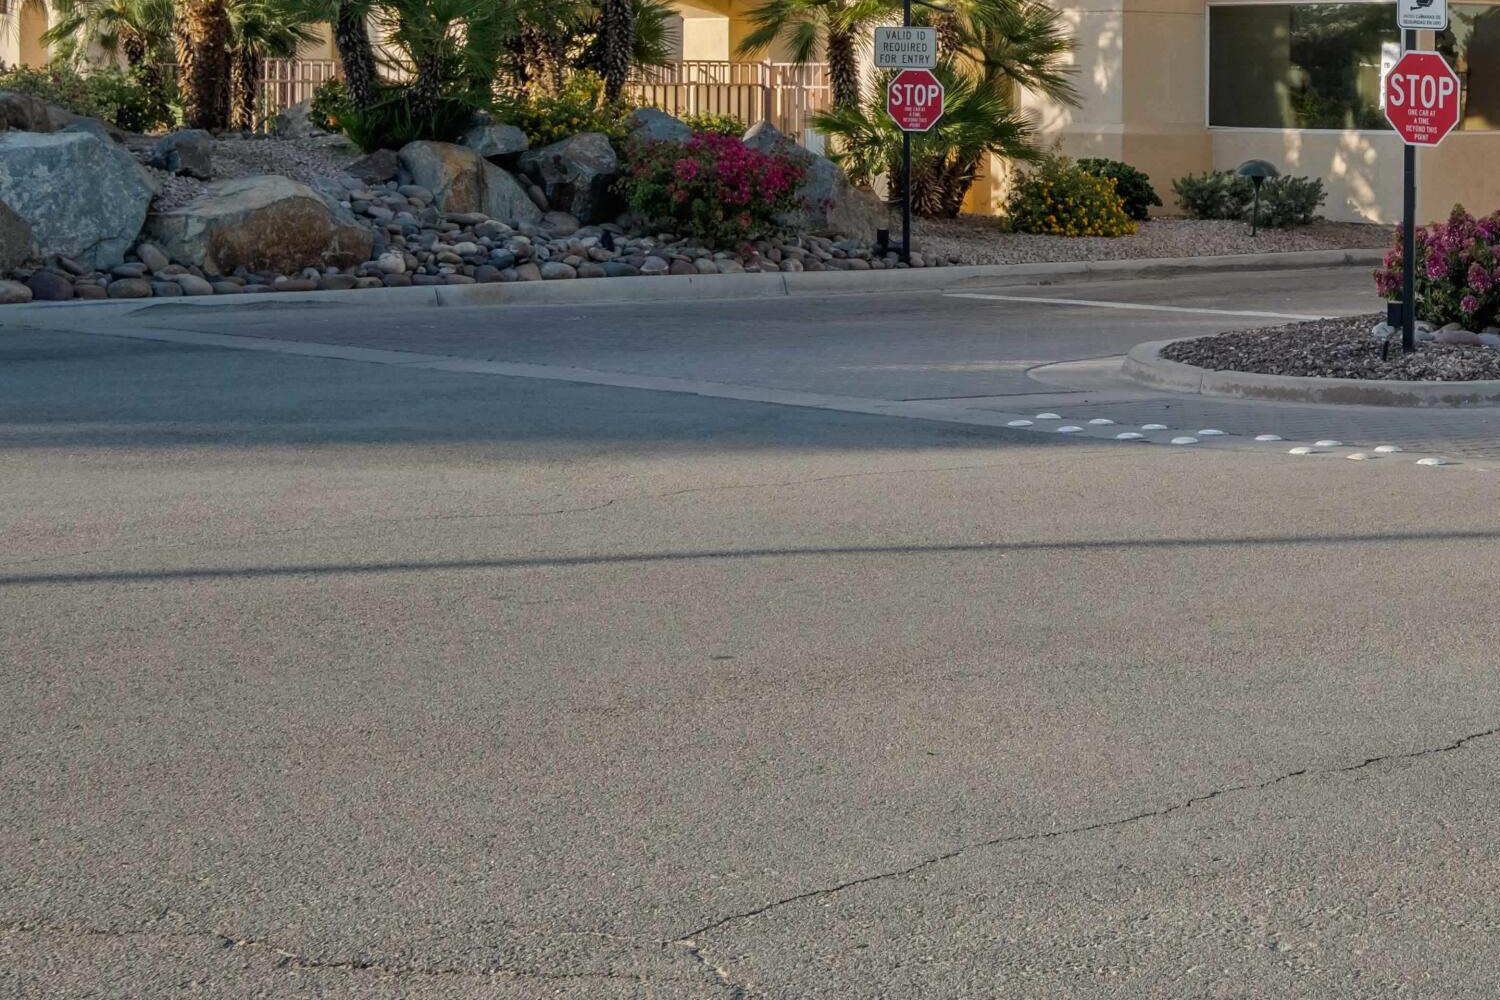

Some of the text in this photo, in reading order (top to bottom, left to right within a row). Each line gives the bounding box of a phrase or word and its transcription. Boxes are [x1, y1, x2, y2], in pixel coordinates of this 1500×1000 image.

[886, 31, 926, 41] VALID ID
[883, 42, 928, 52] REQUIRED
[880, 54, 930, 64] FOR ENTRY
[891, 84, 939, 106] STOP
[1390, 73, 1454, 109] STOP
